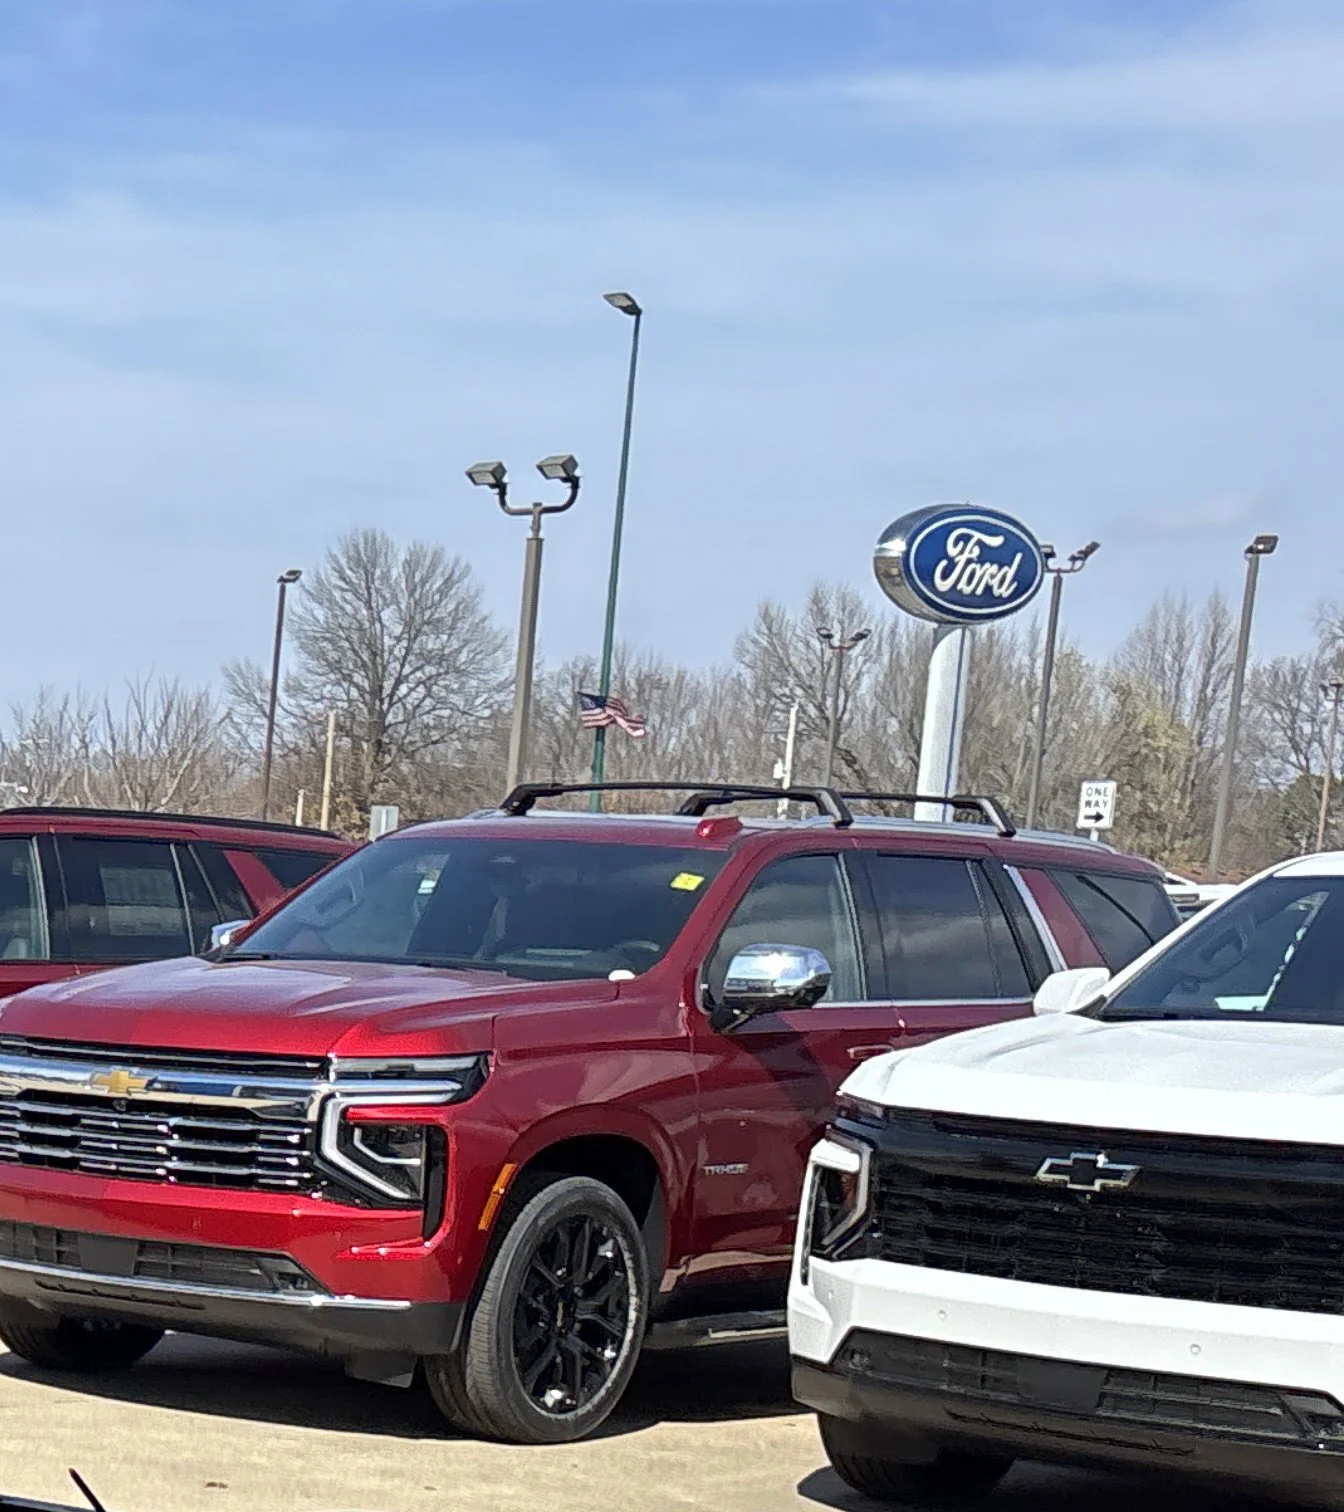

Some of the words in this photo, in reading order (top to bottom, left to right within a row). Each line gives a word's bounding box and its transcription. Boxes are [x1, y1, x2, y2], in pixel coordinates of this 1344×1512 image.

[933, 527, 1024, 599] Ford
[1085, 786, 1109, 798] ONE
[1084, 799, 1109, 809] WAY
